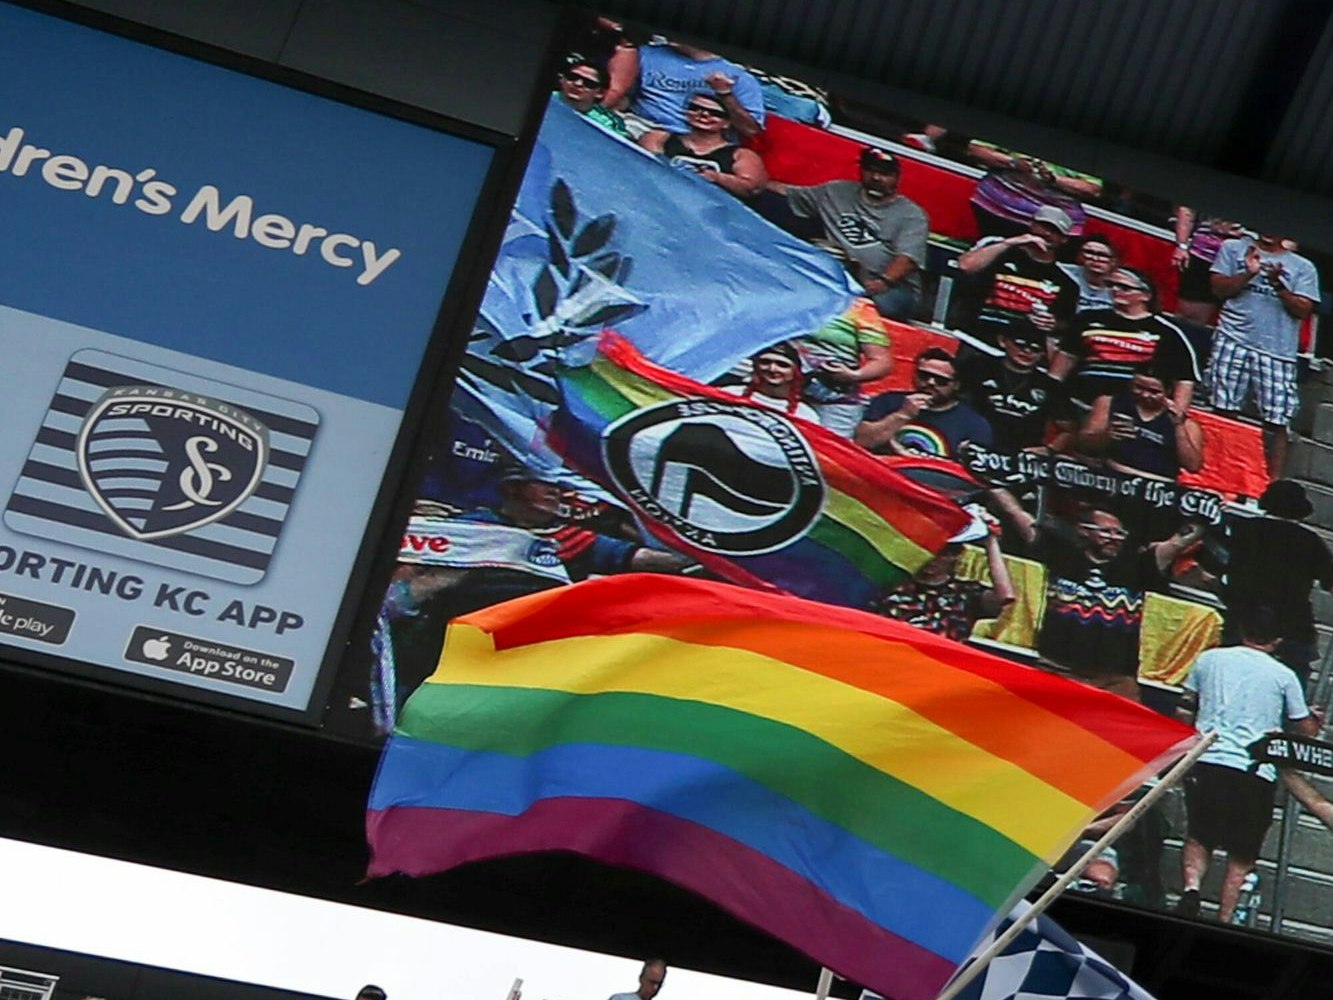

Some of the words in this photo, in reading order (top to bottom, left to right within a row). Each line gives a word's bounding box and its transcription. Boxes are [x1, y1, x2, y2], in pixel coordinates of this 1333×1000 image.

[180, 185, 400, 286] Mercy
[108, 404, 254, 451] SPORTING
[968, 441, 1011, 472] For
[1120, 477, 1142, 496] of
[13, 616, 55, 637] play
[153, 583, 211, 617] KC
[217, 599, 305, 636] APP
[176, 651, 220, 676] App
[221, 661, 277, 687] Store
[183, 641, 240, 662] Download
[260, 658, 280, 670] the
